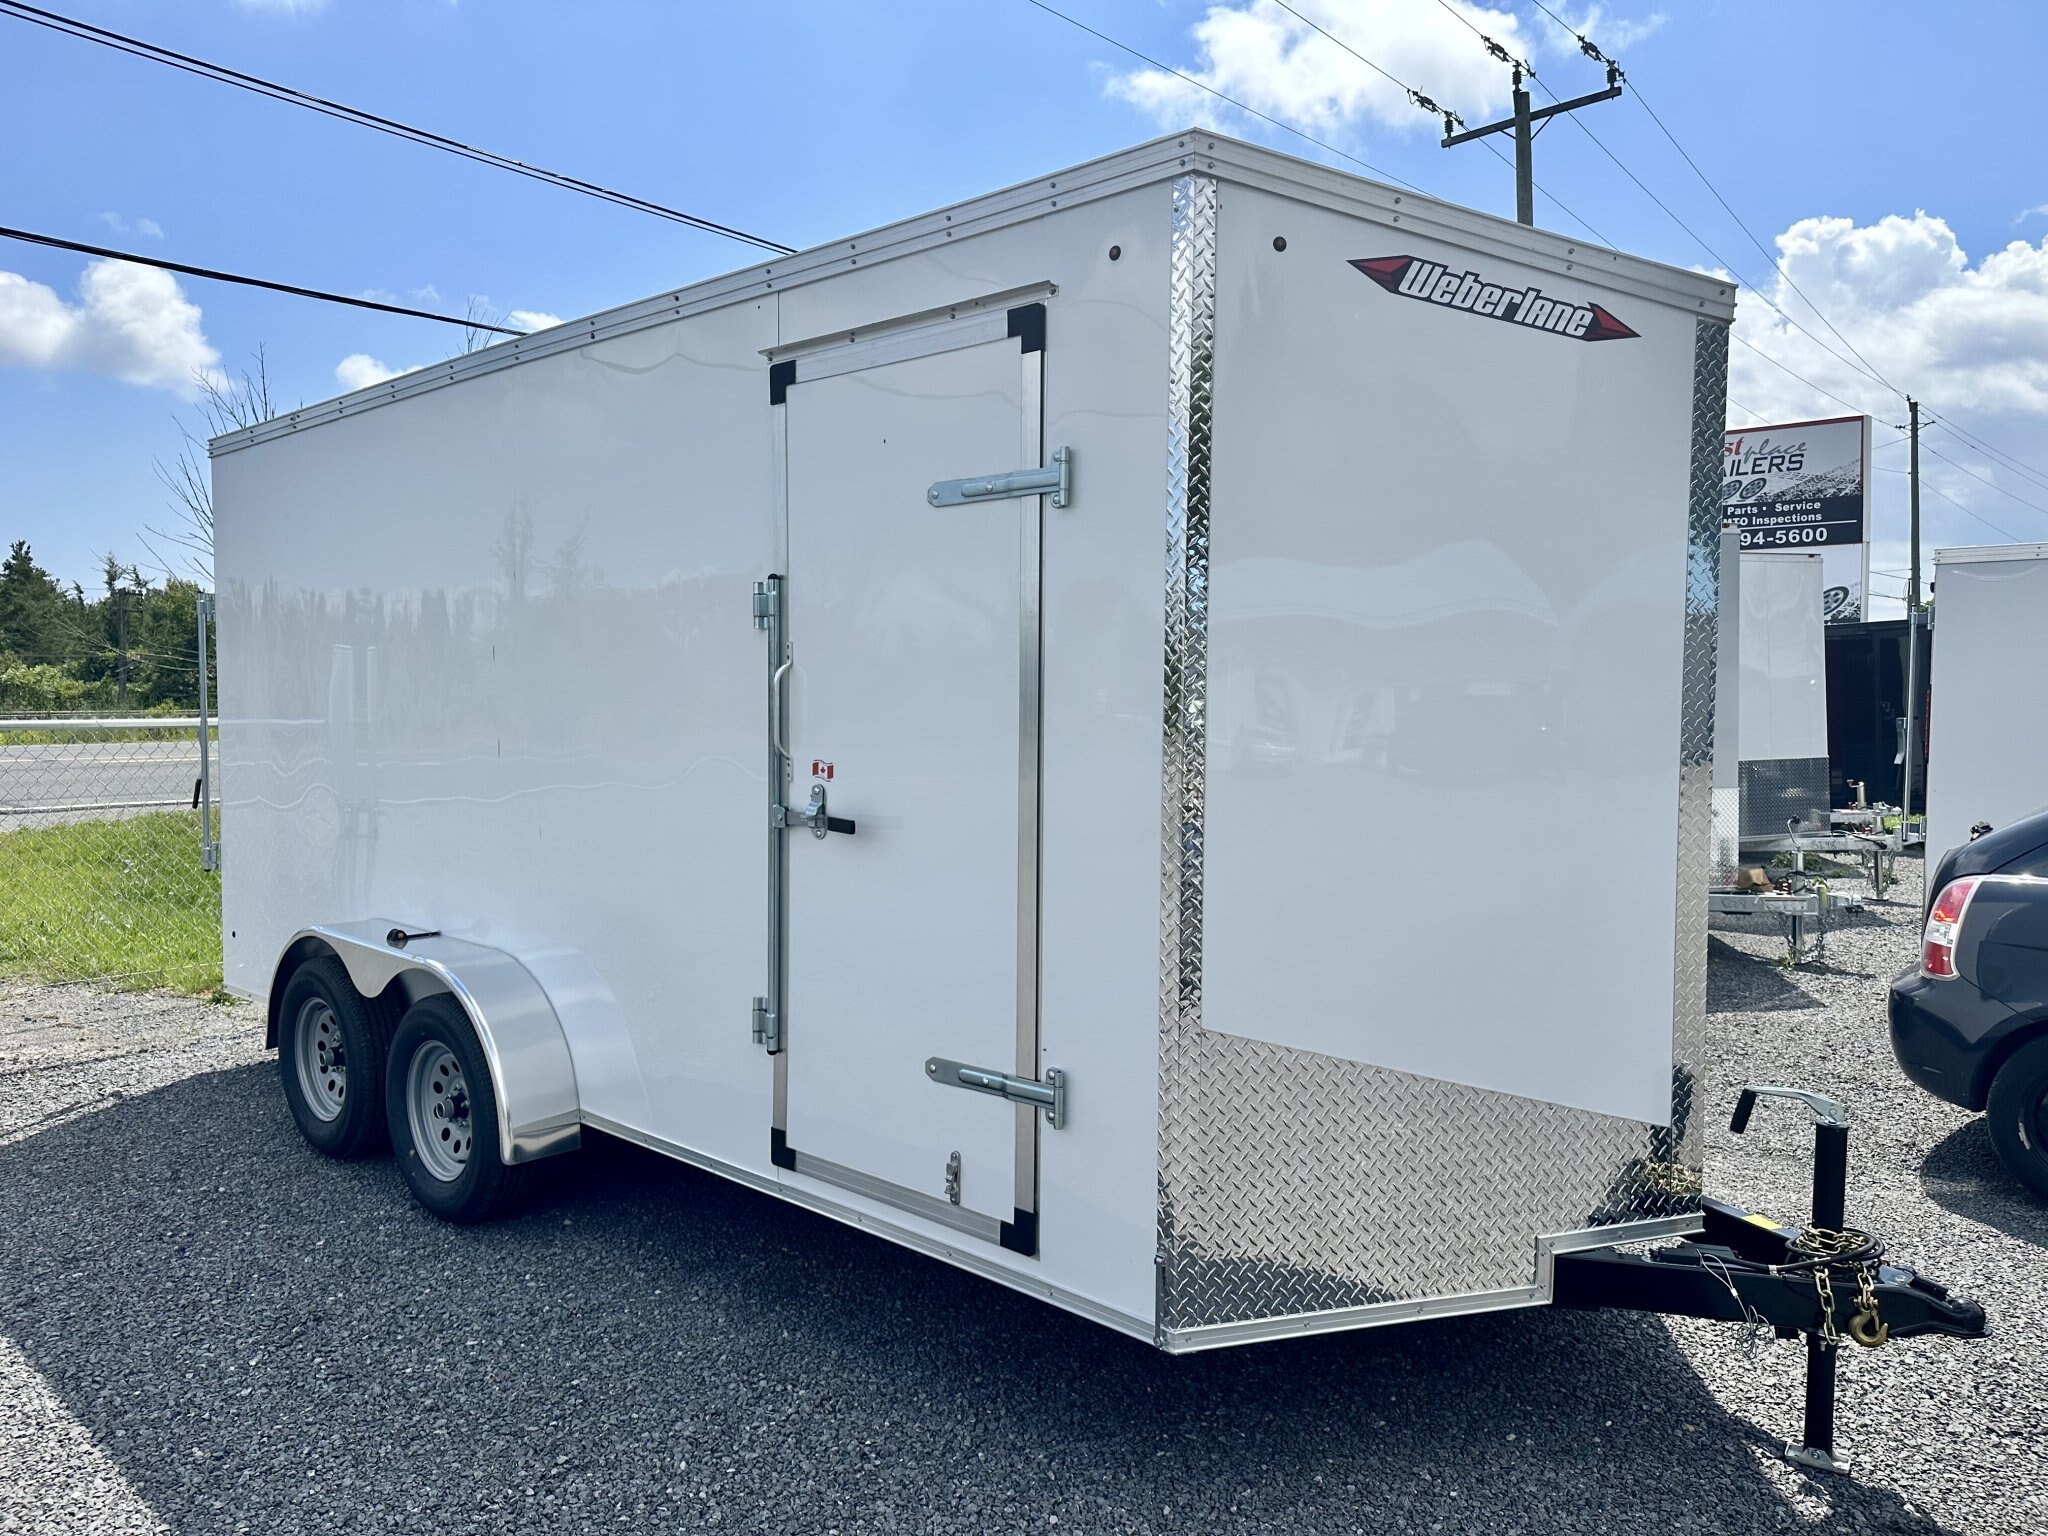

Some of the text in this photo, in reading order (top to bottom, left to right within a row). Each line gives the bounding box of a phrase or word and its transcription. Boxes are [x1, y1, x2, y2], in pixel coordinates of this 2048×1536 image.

[1397, 259, 1594, 337] Weberlane
[1743, 438, 1808, 464] place
[1723, 453, 1805, 477] ILERS
[1727, 501, 1821, 516] Parts Service
[1752, 513, 1822, 526] Inspections
